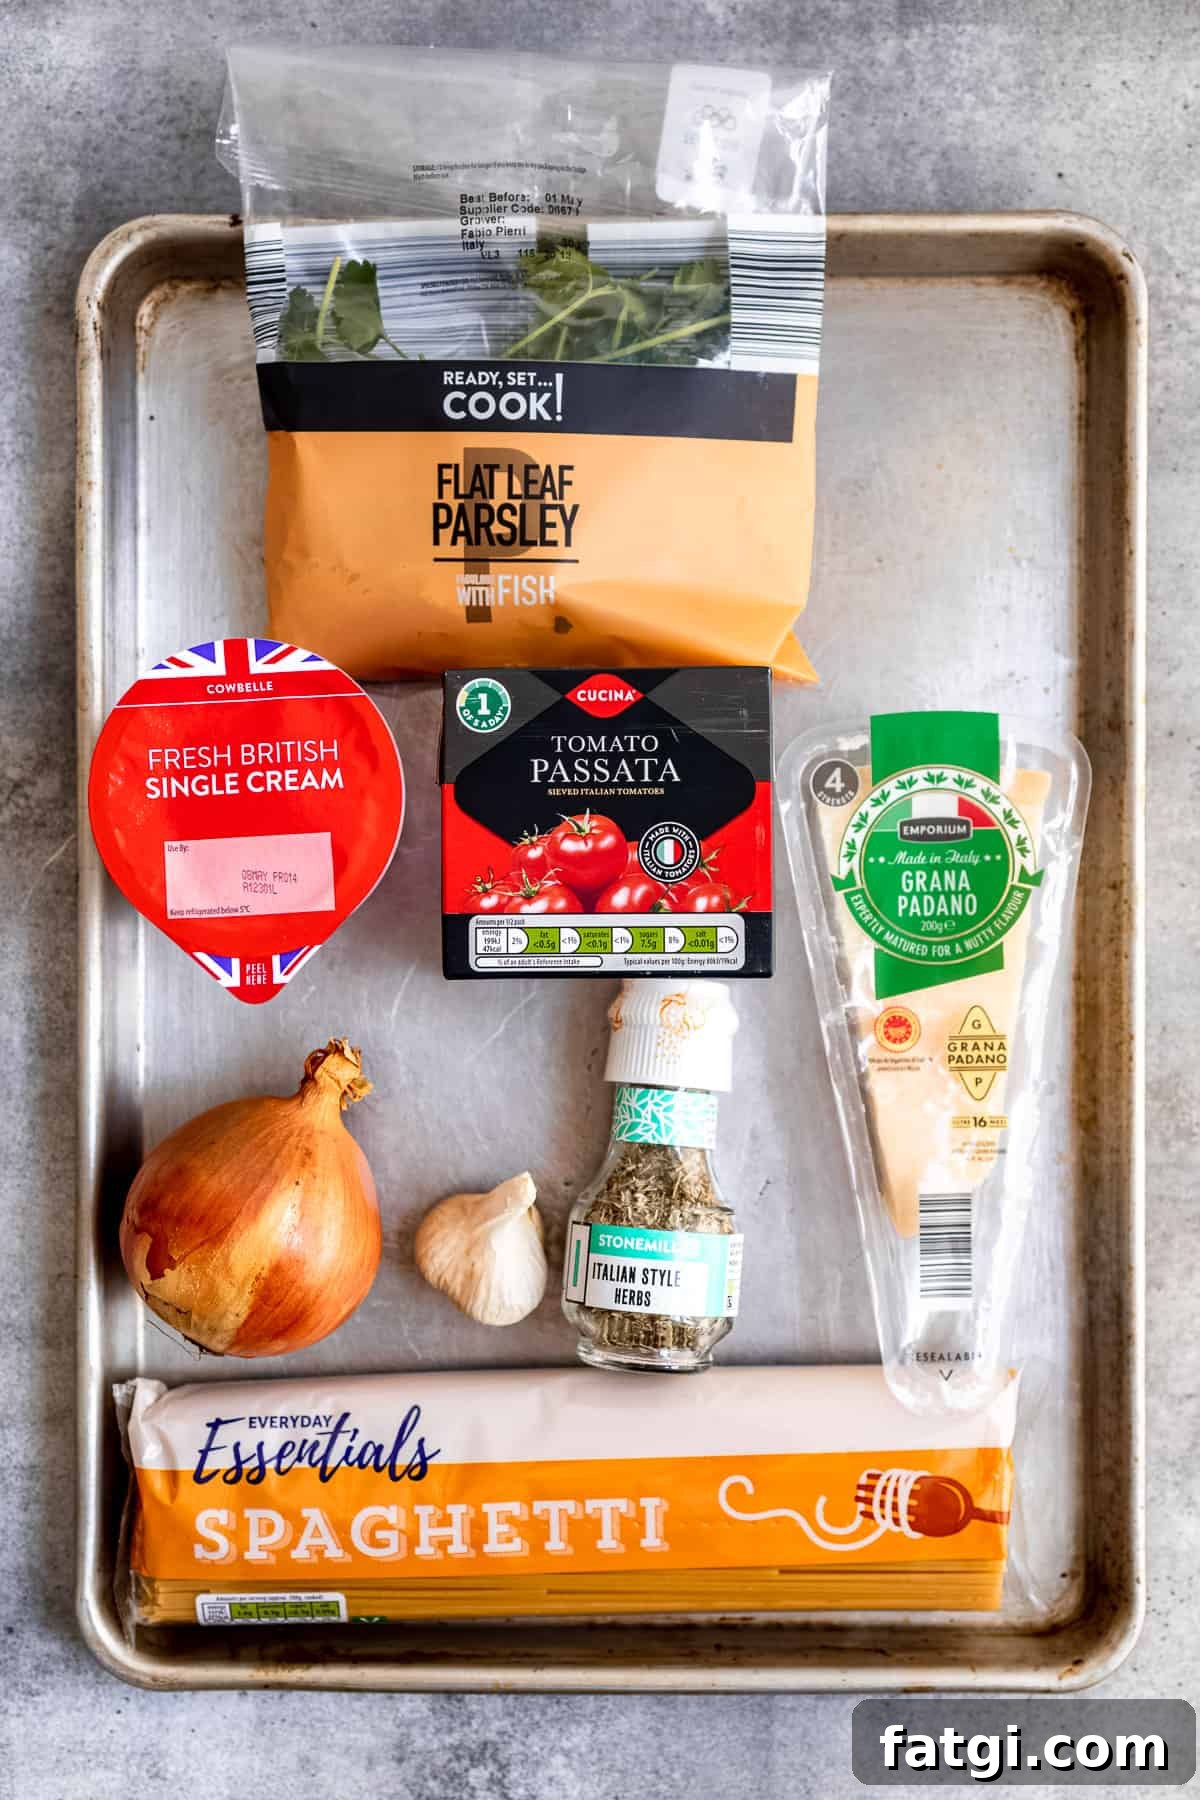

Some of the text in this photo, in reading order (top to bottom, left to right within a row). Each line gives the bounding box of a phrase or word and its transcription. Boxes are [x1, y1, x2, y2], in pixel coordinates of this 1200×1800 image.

[443, 371, 553, 388] READY, SET...
[443, 373, 563, 421] COOK!
[436, 463, 575, 501] FLAT LEAF
[432, 502, 580, 547] PARSLEY
[497, 574, 555, 607] FISH
[206, 681, 274, 694] COWBELLE
[576, 690, 634, 702] CUCINA
[477, 692, 491, 716] 1
[551, 735, 659, 753] TOMATO
[148, 739, 340, 771] FRESH BRITISH
[528, 758, 681, 784] PASSATA
[823, 767, 846, 793] 4
[145, 767, 345, 800] SINGLE CREAM
[547, 787, 665, 797] SIEVED ITALIAN TOMATOES
[648, 826, 670, 841] MADE
[903, 824, 968, 836] EMPORIUM
[887, 848, 981, 866] Made in Italy
[900, 869, 971, 894] GRANA
[897, 893, 978, 918] PADANO
[850, 889, 1026, 958] EXPERTLY MATURED FOR A NUTTY FLAVOUR
[245, 963, 267, 974] PEEL
[972, 1019, 982, 1030] G
[947, 1041, 1008, 1053] GRANA
[947, 1054, 1008, 1065] PADANO
[974, 1077, 984, 1087] P
[972, 1116, 988, 1129] 16
[591, 1262, 681, 1288] ITALIAN STYLE
[614, 1287, 652, 1307] HERBS
[248, 1414, 333, 1429] EVERYDAY
[193, 1404, 441, 1485] Essentials
[193, 1497, 669, 1564] SPAGHETTI
